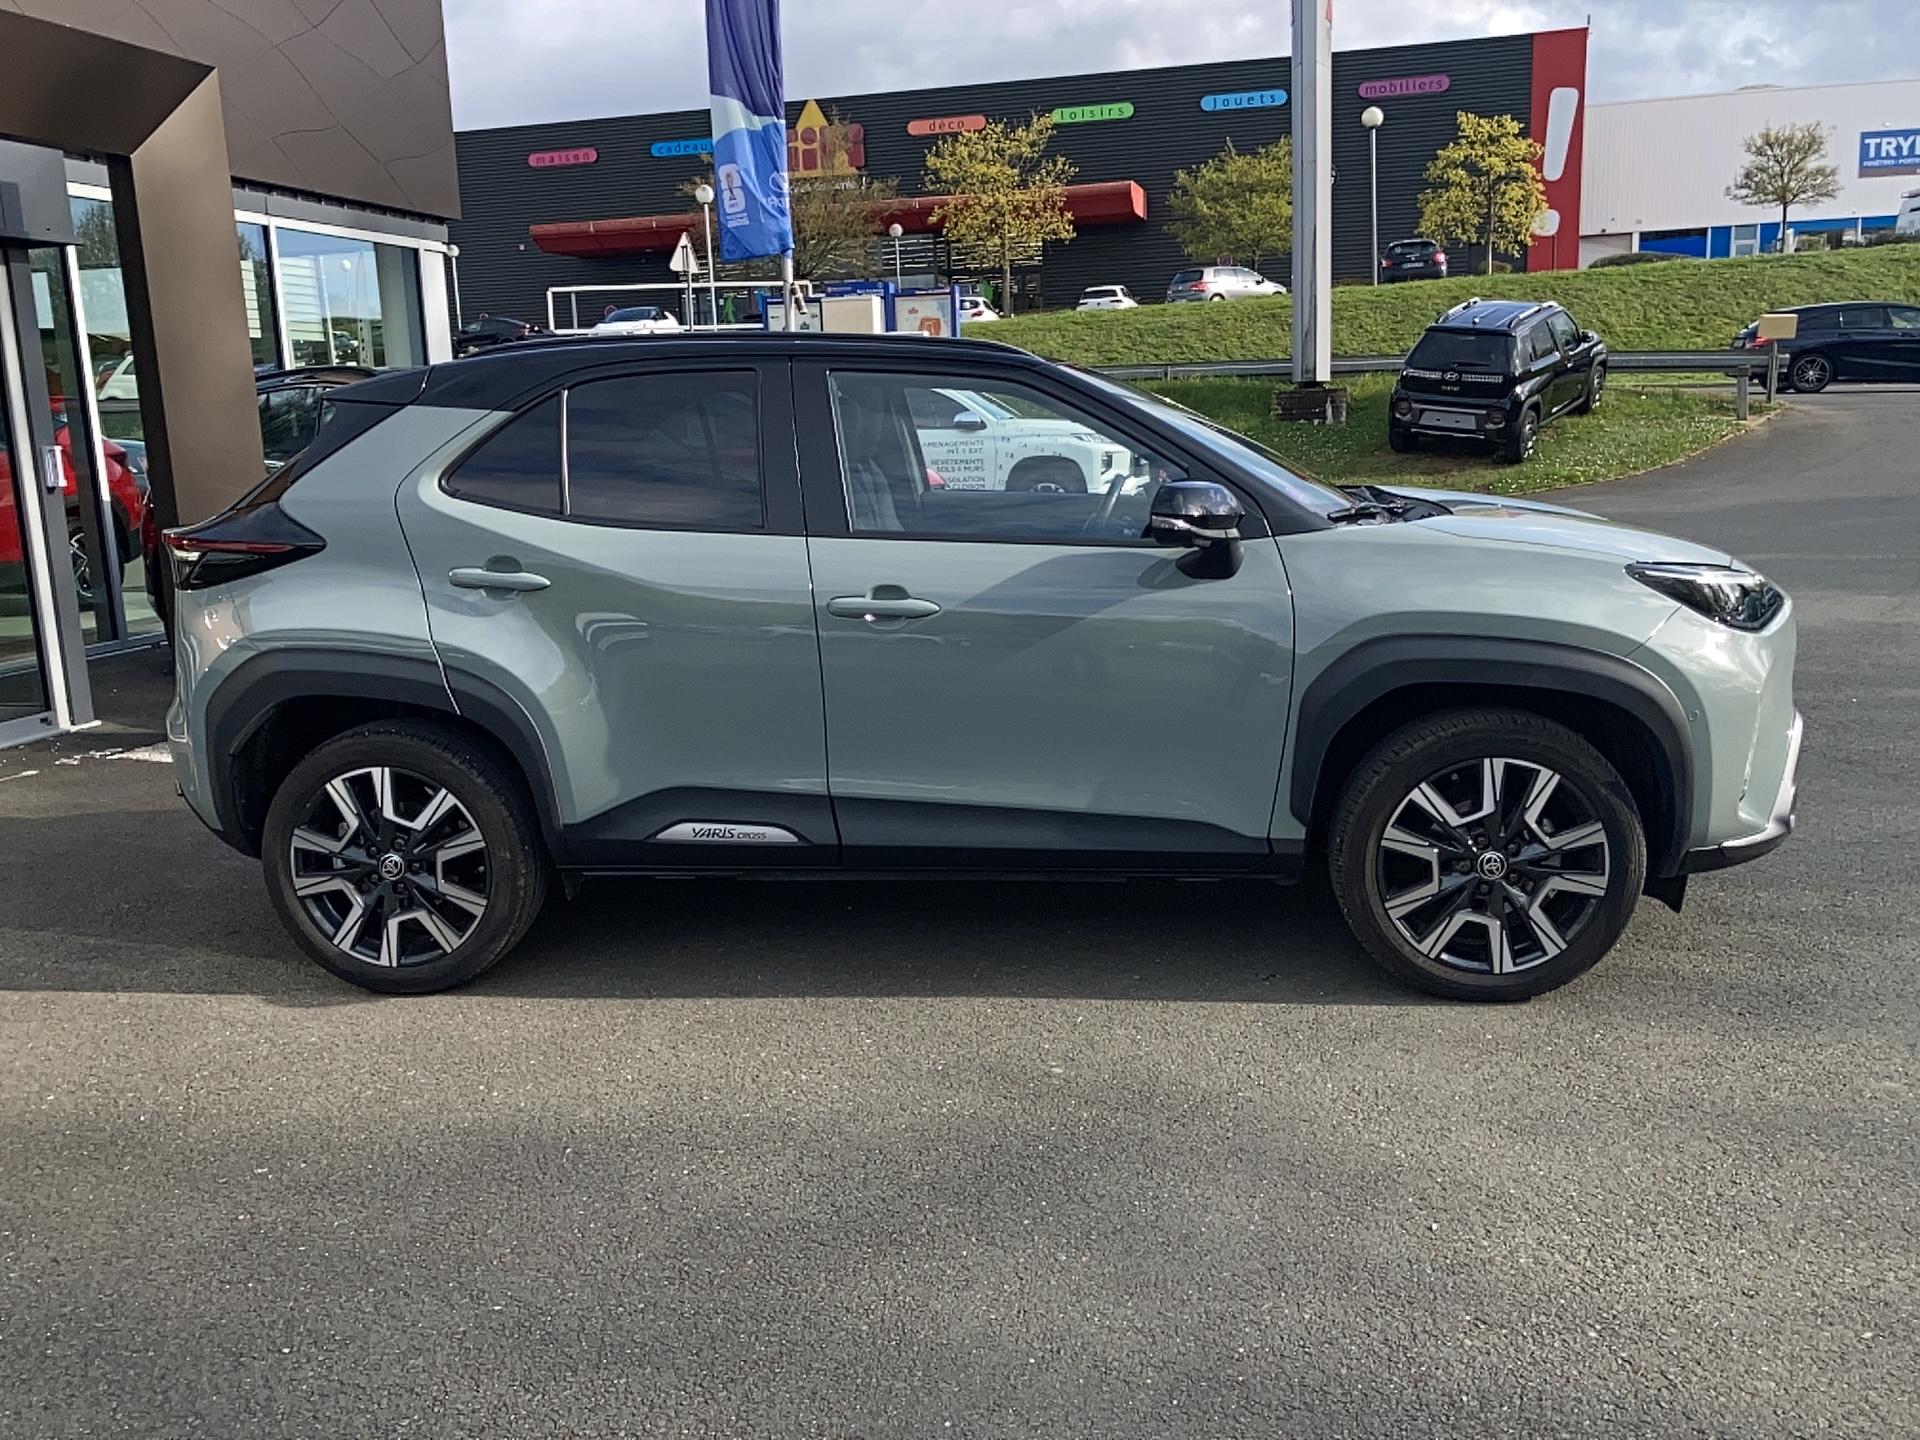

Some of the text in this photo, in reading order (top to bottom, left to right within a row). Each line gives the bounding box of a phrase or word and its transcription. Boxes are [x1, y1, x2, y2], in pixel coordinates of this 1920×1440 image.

[1365, 80, 1443, 95] mobiliers
[1212, 93, 1276, 109] jouets
[1060, 105, 1125, 120] loisirs
[535, 151, 590, 165] maison
[691, 826, 767, 840] YARIS CROSS
